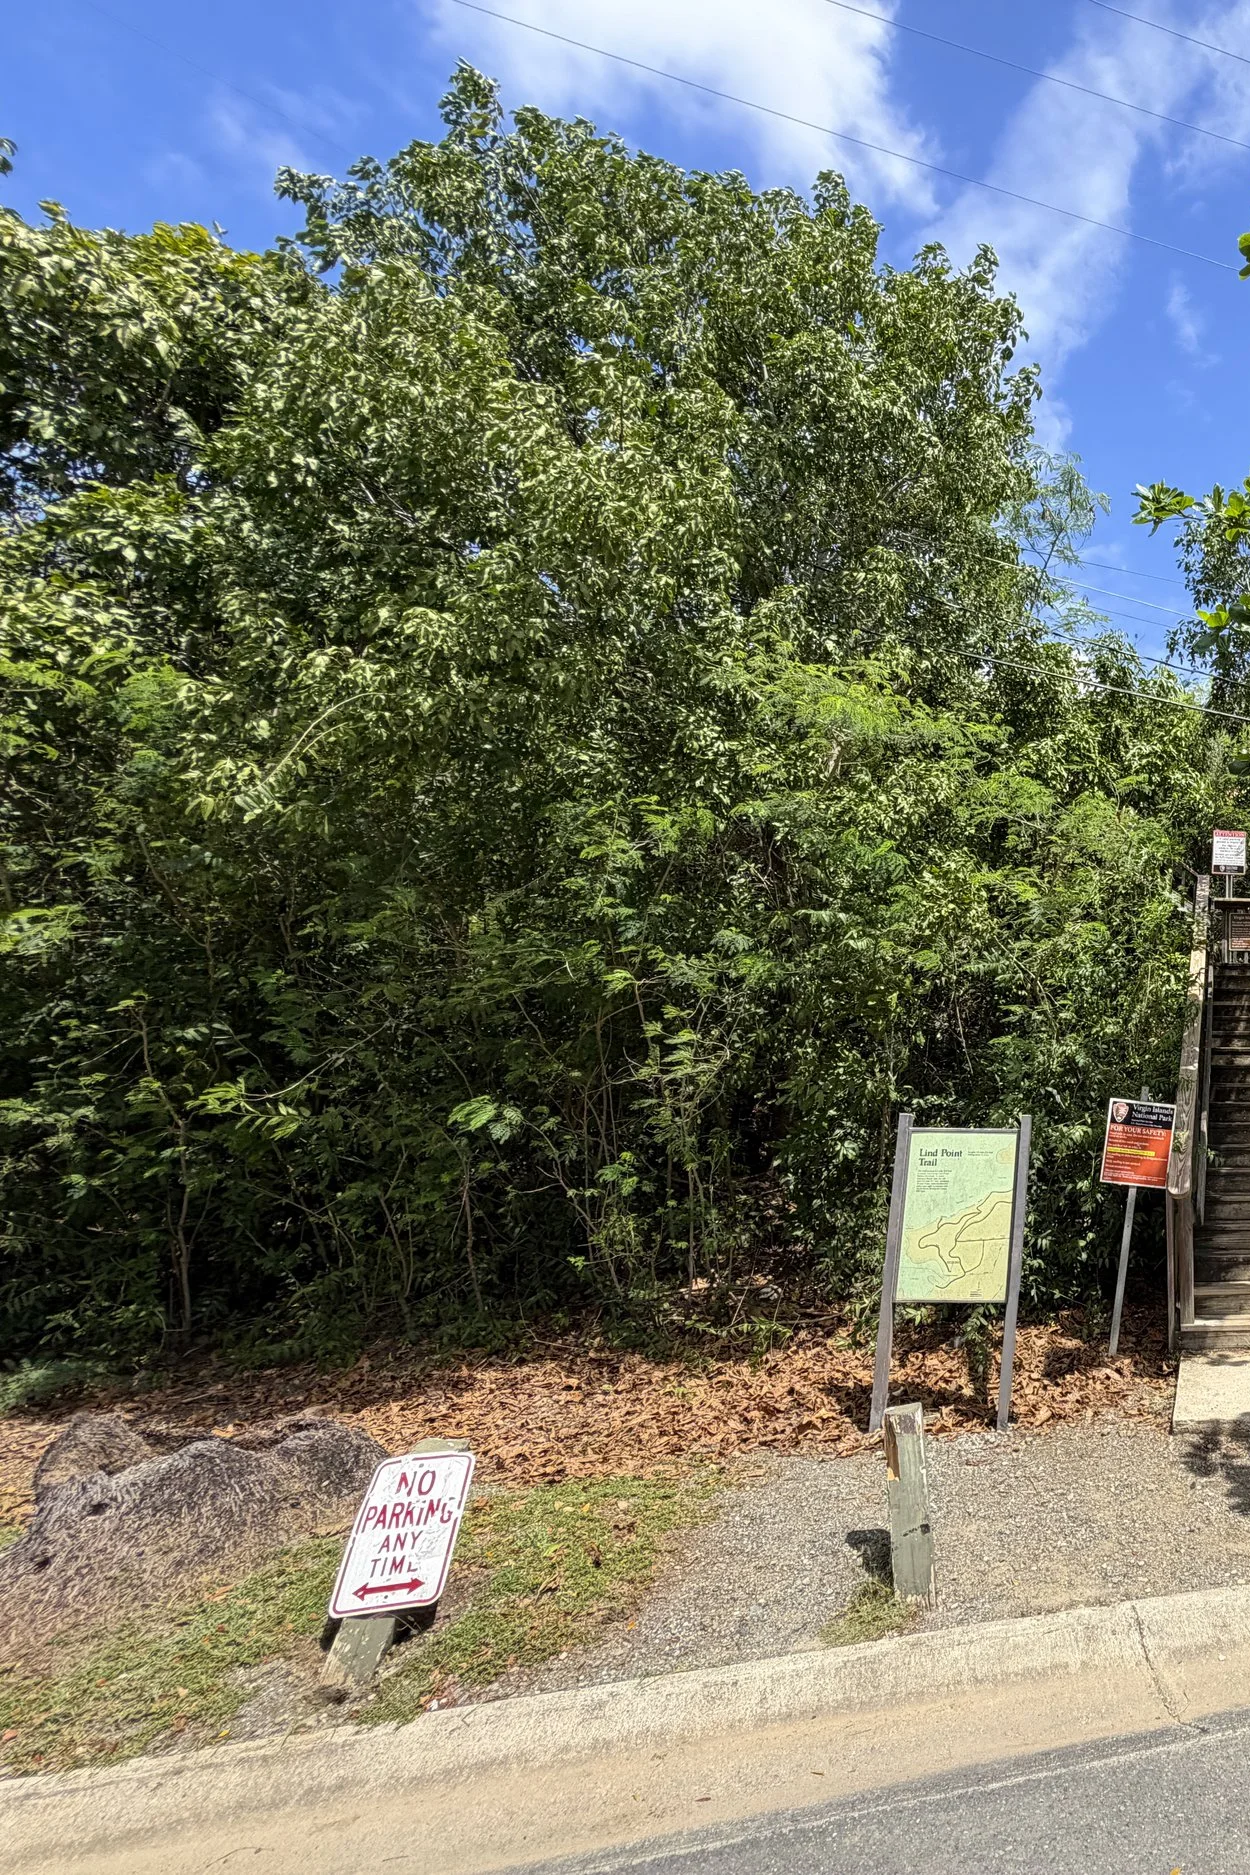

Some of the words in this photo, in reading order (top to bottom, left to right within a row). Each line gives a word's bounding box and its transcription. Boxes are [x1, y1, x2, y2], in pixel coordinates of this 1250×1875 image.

[1133, 1104, 1151, 1113] Virgin
[1152, 1106, 1174, 1115] Islands
[1132, 1111, 1158, 1120] National
[1159, 1114, 1173, 1122] Park
[1110, 1124, 1123, 1132] FOR
[1124, 1126, 1142, 1134] YOUR
[1142, 1128, 1167, 1137] SAFETY:
[919, 1148, 938, 1157] Lind
[940, 1148, 963, 1158] Point
[919, 1158, 938, 1167] Trail
[395, 1469, 436, 1497] NO
[361, 1497, 453, 1534] PARKING
[377, 1530, 423, 1555] ANY
